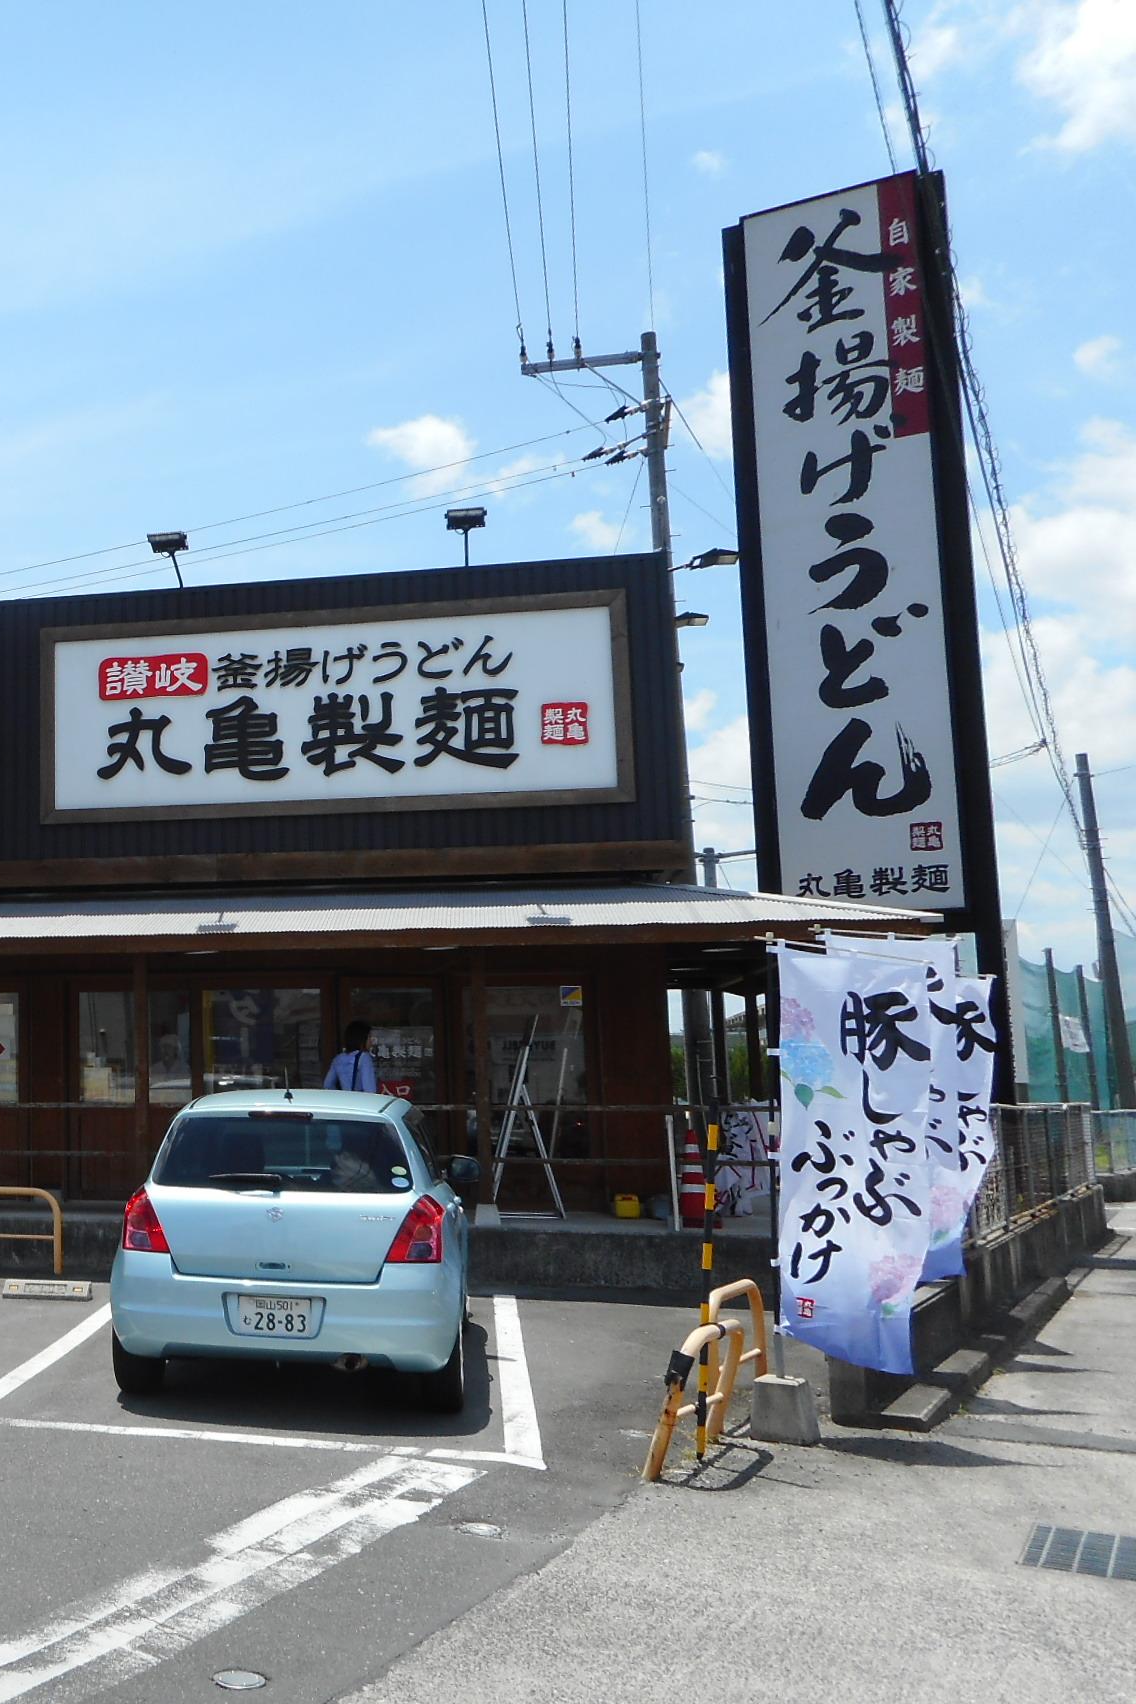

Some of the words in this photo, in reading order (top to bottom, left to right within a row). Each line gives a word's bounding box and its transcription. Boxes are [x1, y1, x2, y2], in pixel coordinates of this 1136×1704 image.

[887, 217, 925, 396] 自家製麺
[757, 208, 931, 821] 釜揚げうどん
[211, 634, 514, 693] 釜揚げうどん
[96, 688, 520, 781] 丸亀製麺
[795, 863, 951, 899] 丸亀製麺
[840, 991, 931, 1226] 豚しゃぶ
[790, 1120, 855, 1284] ぶっかけ
[254, 1312, 307, 1333] 28-83
